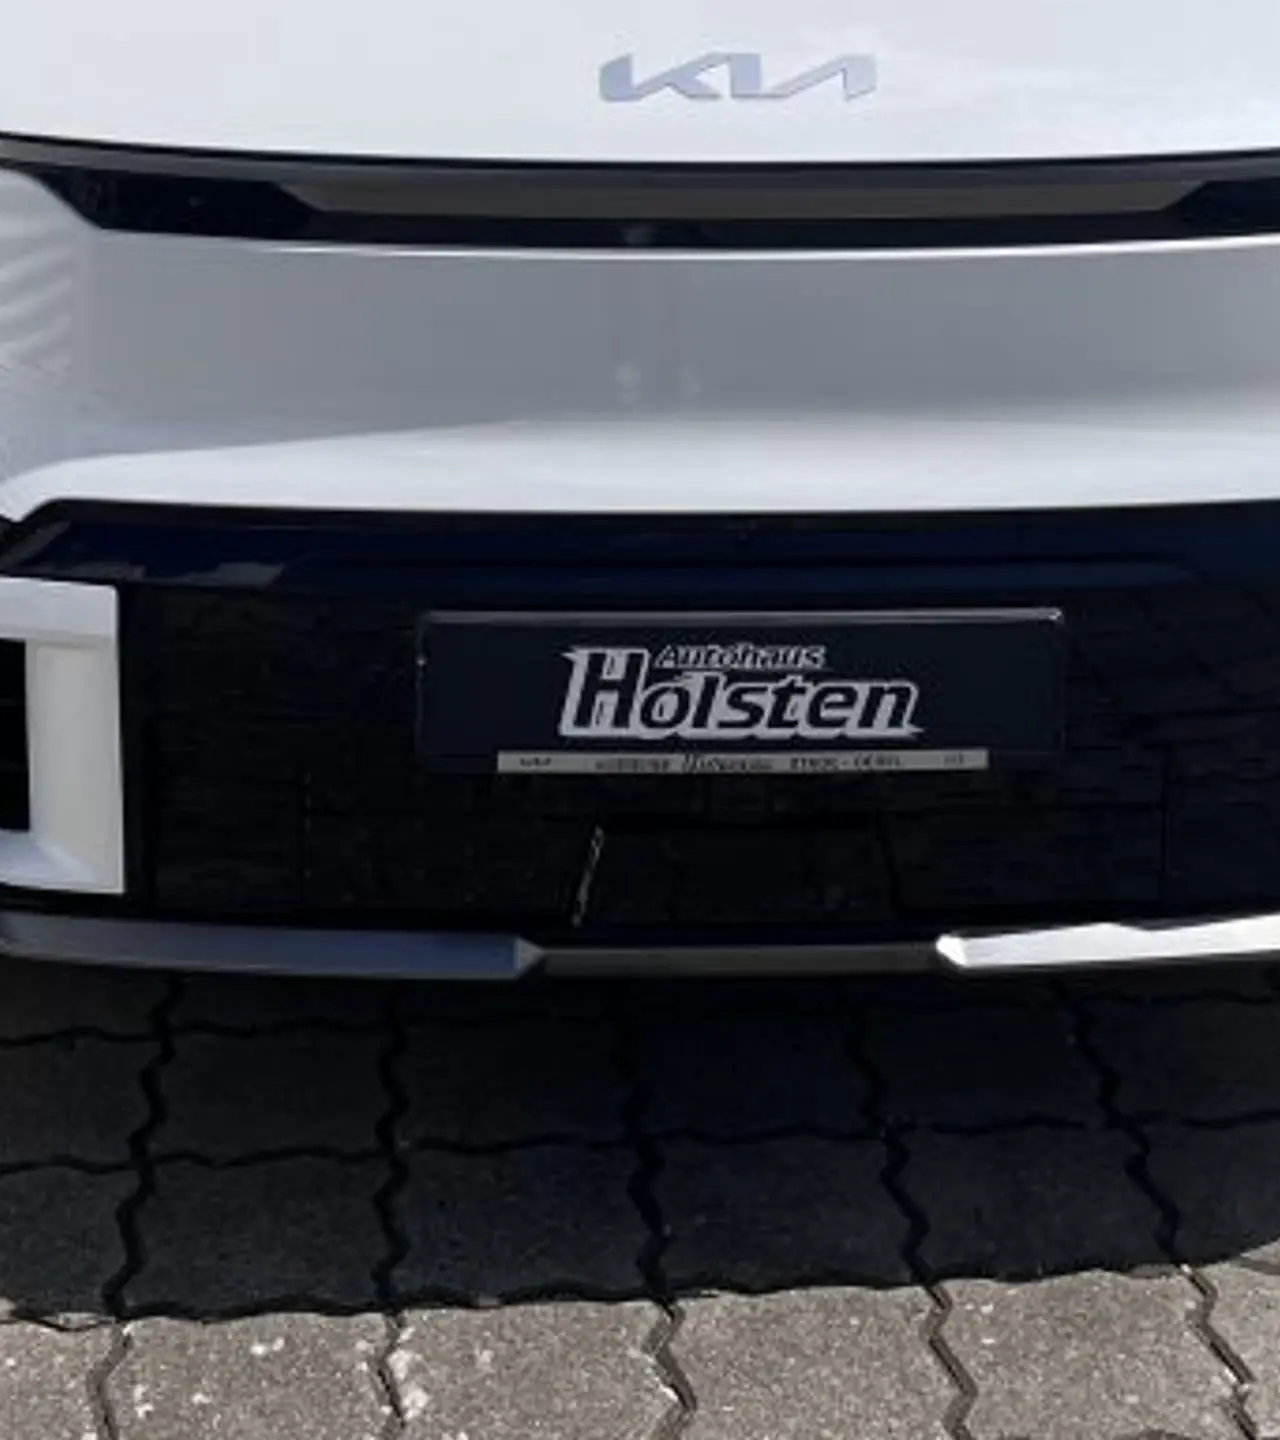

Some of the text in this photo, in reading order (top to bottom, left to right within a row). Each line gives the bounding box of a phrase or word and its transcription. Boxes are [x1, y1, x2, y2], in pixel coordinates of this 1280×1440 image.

[598, 52, 878, 102] KIA
[654, 643, 827, 670] Autohaus
[558, 647, 925, 739] Holsten
